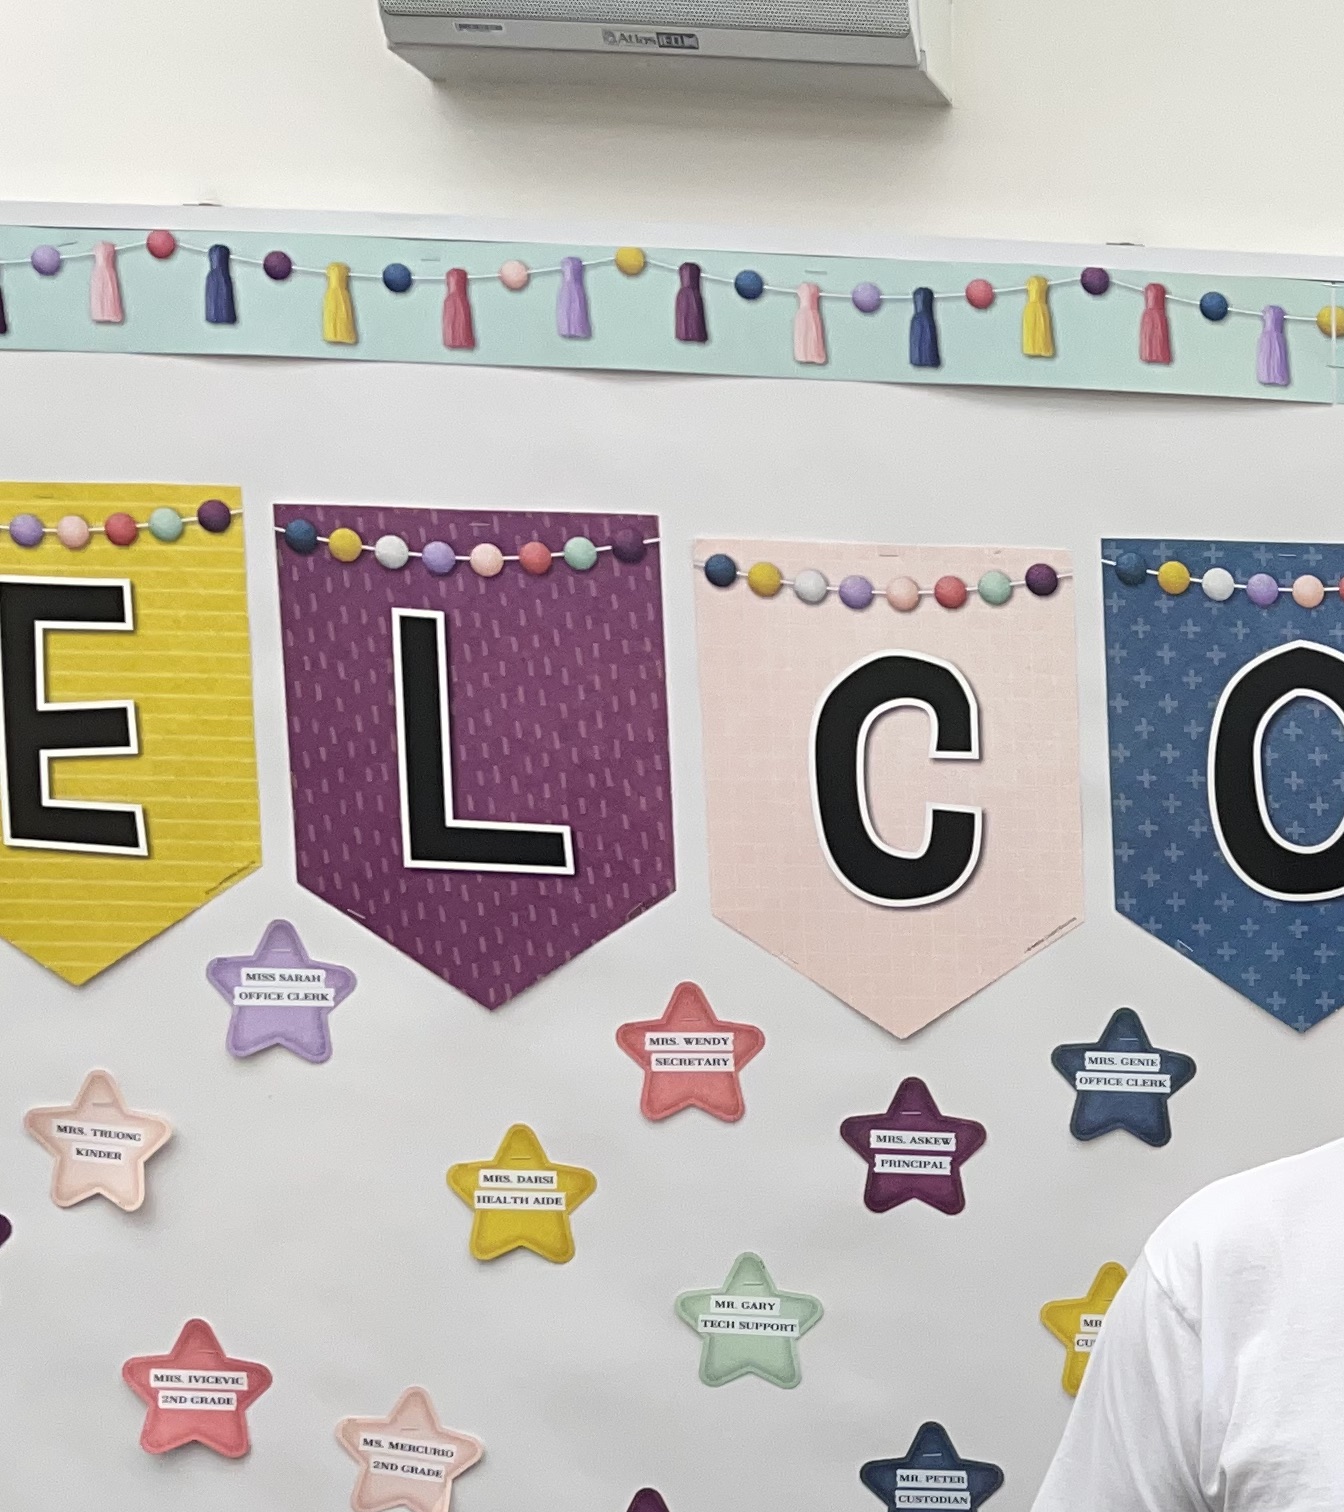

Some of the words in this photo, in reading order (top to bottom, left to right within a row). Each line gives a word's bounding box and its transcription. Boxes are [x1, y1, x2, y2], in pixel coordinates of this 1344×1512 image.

[245, 972, 275, 983] MISS
[279, 972, 321, 983] SARAH
[239, 991, 284, 1002] OFFICE
[288, 992, 329, 1001] CLERK
[649, 1037, 679, 1046] MRS.
[684, 1036, 729, 1047] WENDY
[655, 1058, 729, 1067] SECRETARY
[1087, 1056, 1116, 1066] MRS.
[1121, 1057, 1158, 1067] GENIE
[1079, 1076, 1123, 1086] OFFICE
[1127, 1077, 1167, 1088] CLERK
[57, 1124, 88, 1136] MRS.
[92, 1127, 142, 1141] TRUONG
[876, 1135, 905, 1145] MRS.
[910, 1135, 953, 1146] ASKEW
[75, 1148, 122, 1160] KINDER
[880, 1159, 946, 1170] PRINCIPAL
[483, 1174, 513, 1185] MRS.
[517, 1174, 554, 1185] DARSI
[476, 1195, 528, 1206] HEALTH
[532, 1195, 563, 1206] AIDE
[741, 1300, 776, 1311] GARY
[701, 1320, 735, 1331] TECH
[739, 1321, 797, 1333] SUPPORT
[153, 1374, 184, 1385] MRS.
[188, 1375, 244, 1386] IVICEVIC
[161, 1395, 187, 1406] 2ND
[190, 1395, 235, 1407] GRADE
[363, 1437, 385, 1449] MS.
[388, 1442, 455, 1458] MERCURIO
[372, 1461, 398, 1473] 2ND
[401, 1465, 443, 1478] GRADE
[925, 1475, 966, 1485] PETER
[898, 1494, 968, 1506] CUSTODIAN
